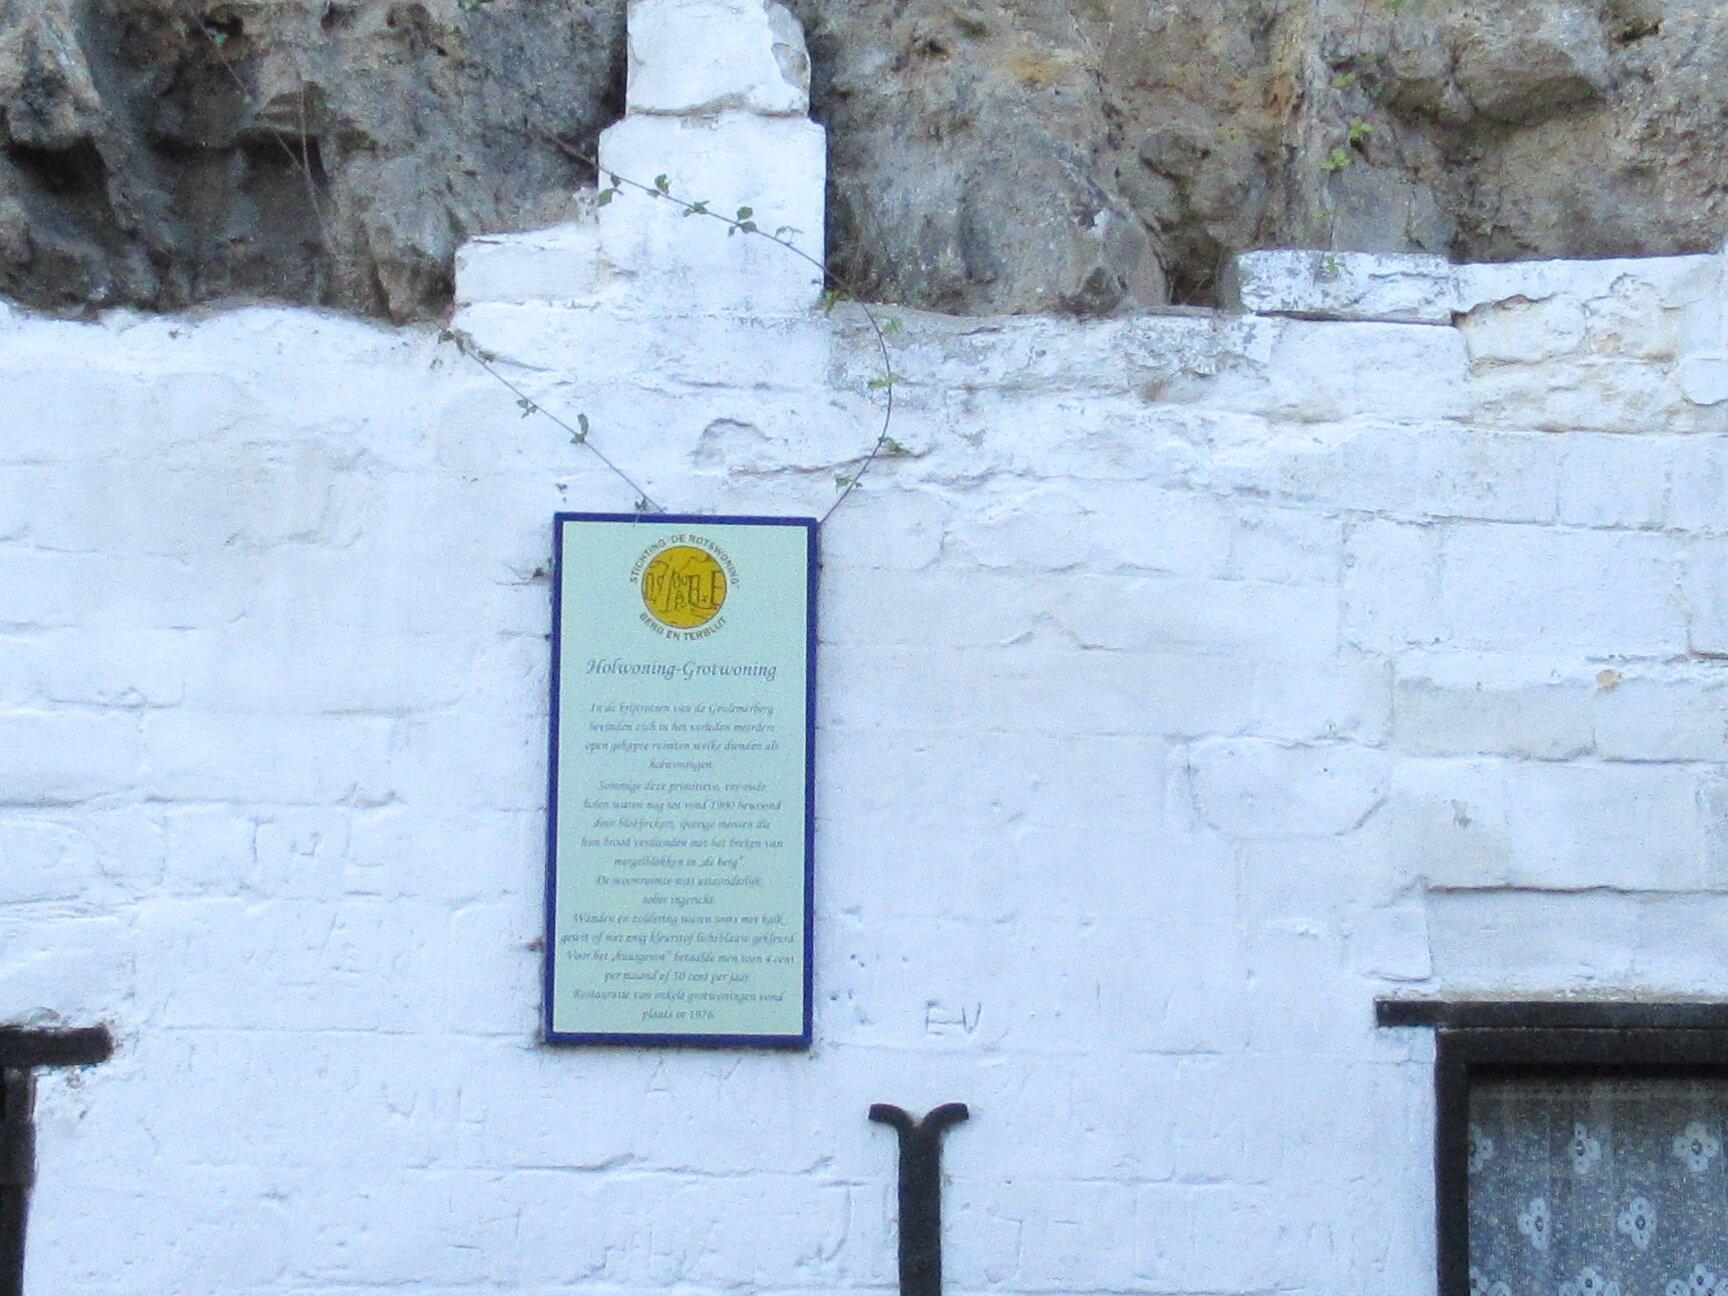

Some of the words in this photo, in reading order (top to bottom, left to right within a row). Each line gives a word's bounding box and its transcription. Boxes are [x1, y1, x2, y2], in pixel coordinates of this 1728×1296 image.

[629, 539, 666, 583] STICHTING
[639, 612, 664, 635] BERG
[666, 630, 680, 641] EN
[586, 658, 777, 682] Holwoning-Grotwoning
[674, 705, 692, 713] van
[693, 703, 706, 713] de
[658, 724, 668, 732] in
[671, 722, 686, 732] het
[584, 741, 608, 752] open
[693, 740, 721, 751] welke
[647, 802, 664, 813] nog
[765, 840, 783, 849] van
[686, 858, 696, 867] in
[595, 876, 610, 886] De
[573, 913, 614, 924] Wanden
[617, 916, 629, 924] en
[681, 915, 711, 924] waren
[741, 916, 759, 924] met
[626, 934, 647, 945] enig
[593, 951, 608, 961] het
[718, 955, 737, 964] men
[741, 954, 762, 964] toen
[604, 973, 622, 983] per
[623, 970, 659, 982] maand
[659, 971, 671, 984] of
[688, 972, 709, 982] cent
[710, 973, 729, 985] per
[676, 1011, 686, 1020] in
